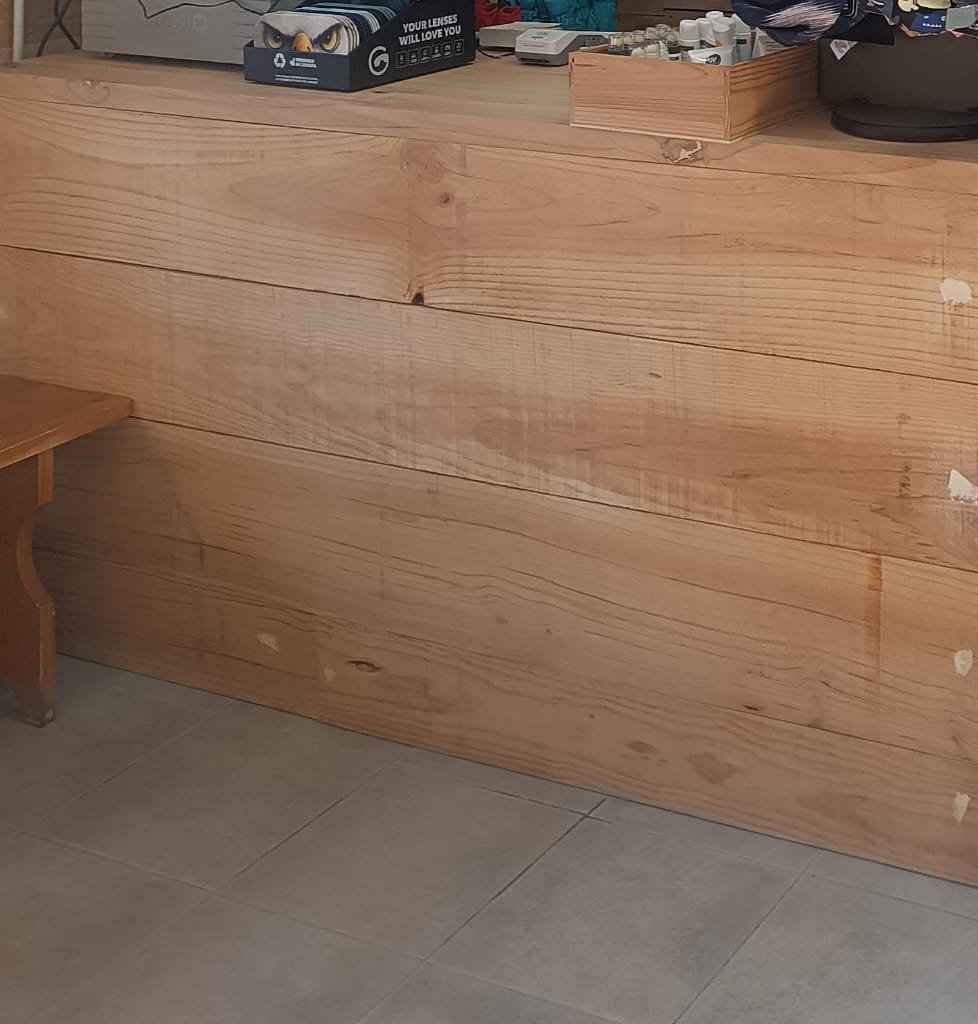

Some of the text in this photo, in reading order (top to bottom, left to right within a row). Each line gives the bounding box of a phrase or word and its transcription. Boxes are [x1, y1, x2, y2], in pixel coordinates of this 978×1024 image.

[402, 14, 458, 33] YOUR LENSES
[399, 26, 462, 46] WILL LOVE YOU
